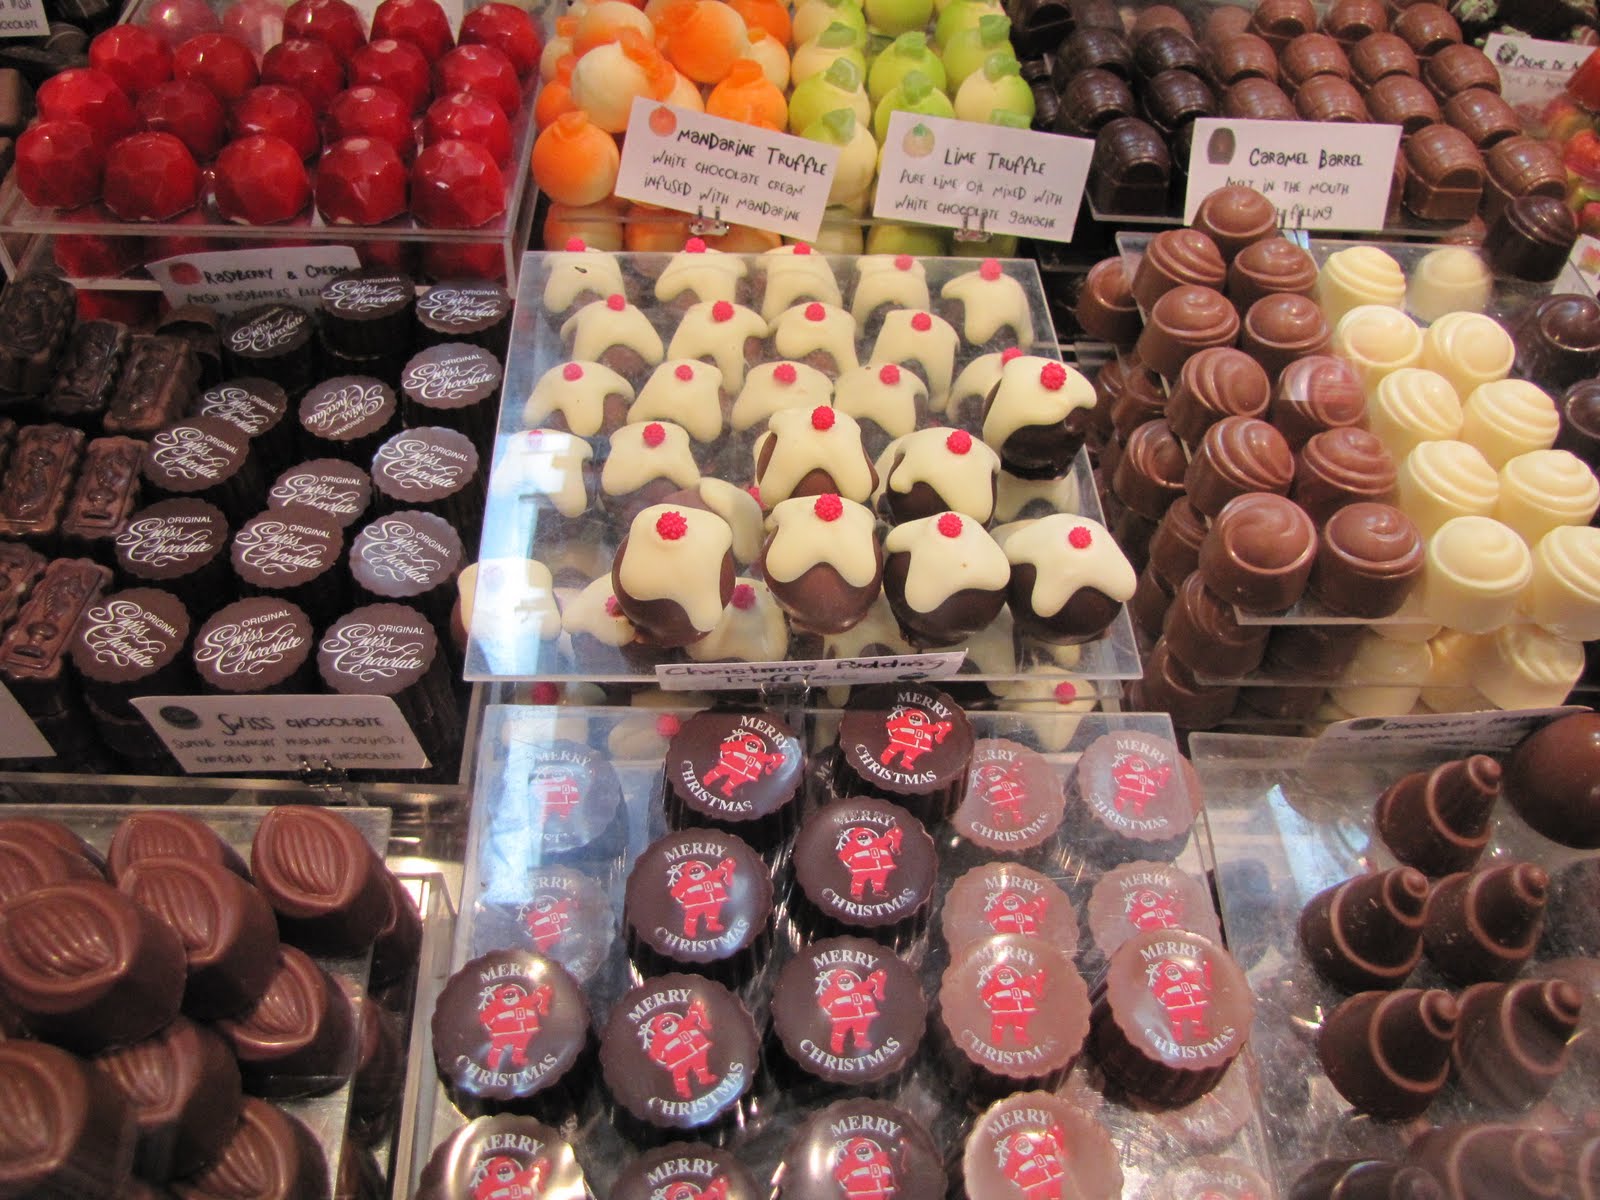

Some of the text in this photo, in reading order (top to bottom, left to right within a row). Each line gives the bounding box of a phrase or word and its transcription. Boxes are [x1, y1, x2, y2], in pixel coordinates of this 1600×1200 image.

[440, 354, 482, 366] ORIGINAL
[205, 435, 239, 454] ORIGINAL
[430, 445, 468, 462] ORIGINAL
[320, 475, 361, 486] ORIGINAL
[289, 524, 331, 538] ORIGINAL
[415, 532, 451, 557] ORIGINAL
[143, 611, 178, 638] ORIGINAL
[242, 609, 291, 628] ORIGINAL
[378, 625, 424, 635] ORIGINAL
[195, 624, 264, 661] Swiss
[216, 623, 304, 674] Chocolate
[897, 692, 953, 718] MERRY
[740, 715, 792, 750] MERRY
[855, 743, 937, 785] CHRISTMAS
[976, 749, 1018, 763] ERRY
[1116, 739, 1169, 764] MERRY
[681, 759, 753, 812] CHRISTMAS
[1089, 792, 1169, 831] CHRISTMAS
[971, 812, 1050, 841] CHRISTMAS
[664, 842, 727, 863] MERRY
[985, 875, 1044, 894] MERRY
[1119, 873, 1173, 890] MERRY
[822, 887, 916, 918] CHRISTMAS
[655, 918, 750, 953] CHRISTMAS
[813, 949, 879, 970] MERRY
[1140, 941, 1203, 962] MERRY
[626, 988, 692, 1023] MERRY
[799, 1037, 901, 1072] CHRISTMAS
[1144, 1025, 1237, 1059] CHRISTMAS
[456, 1053, 559, 1087] CHRISTMAS
[649, 1062, 745, 1116] CHRISTMAS
[831, 1115, 901, 1138] MERRY
[987, 1108, 1054, 1139] MERRY
[648, 1158, 720, 1186] MERRY
